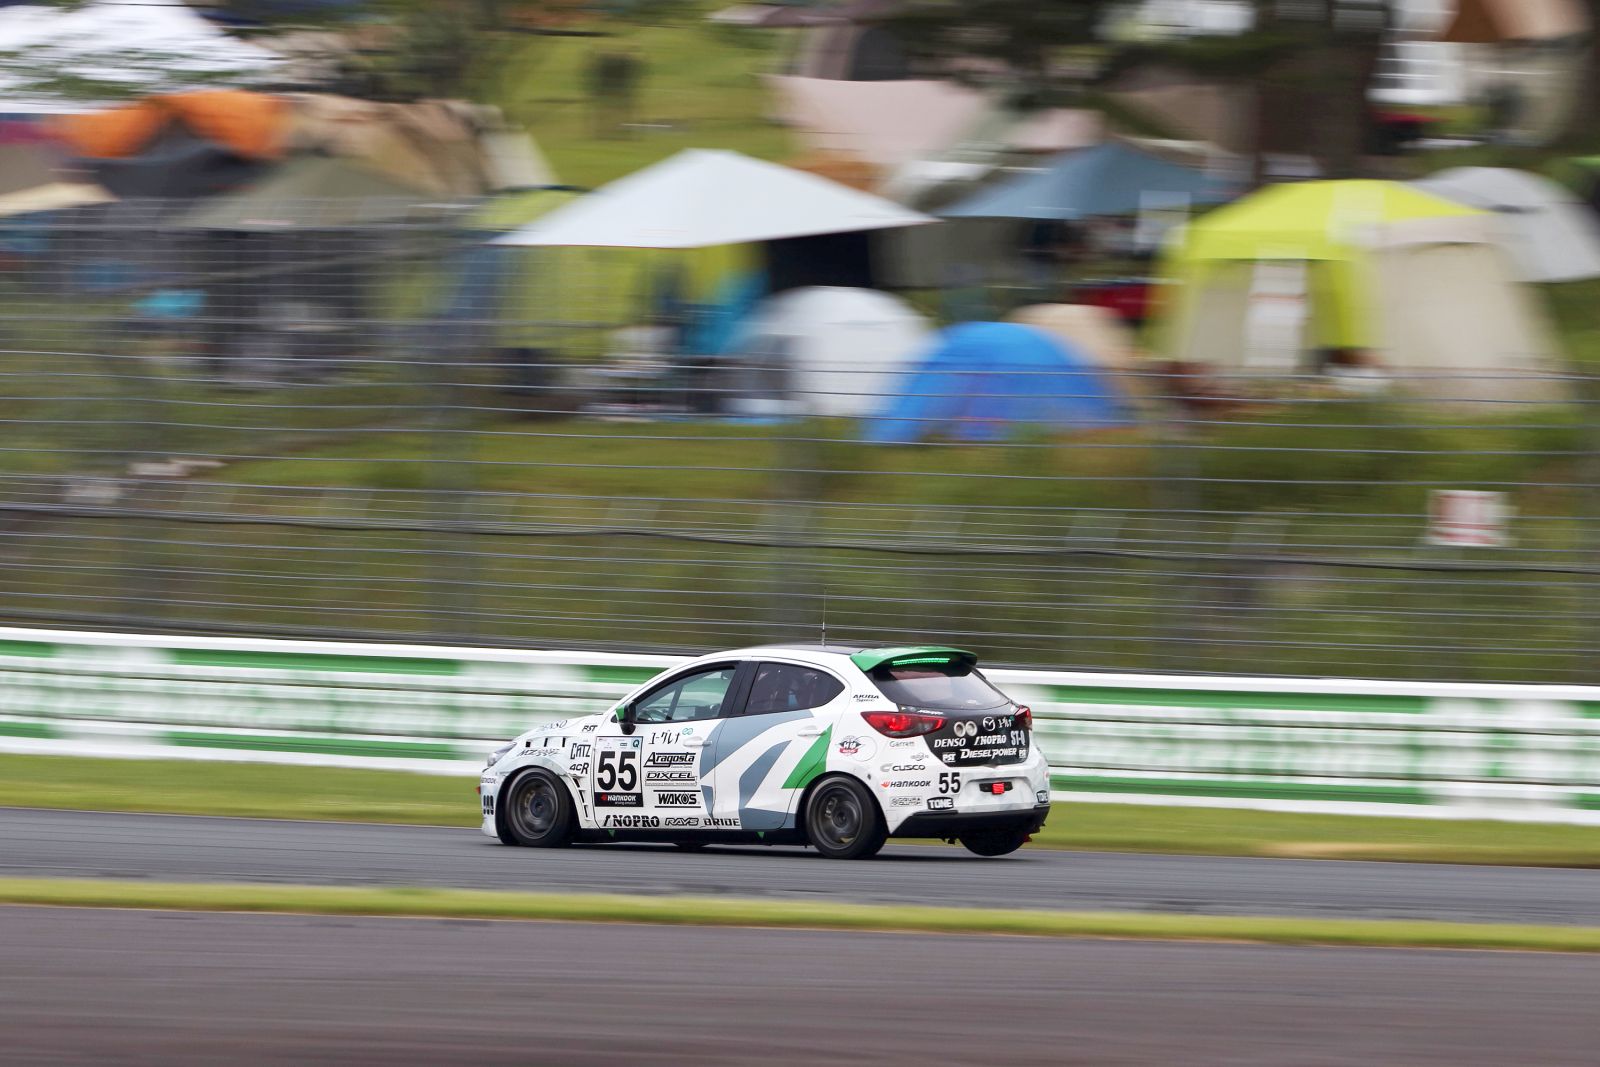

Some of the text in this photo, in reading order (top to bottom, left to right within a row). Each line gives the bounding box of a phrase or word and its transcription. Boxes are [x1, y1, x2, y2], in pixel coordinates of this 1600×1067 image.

[632, 739, 640, 748] Q
[934, 738, 966, 748] DENSO
[570, 742, 591, 760] CATZ
[643, 752, 696, 768] Aragosta
[597, 751, 637, 791] 55
[892, 764, 926, 772] CUSCO
[646, 772, 696, 781] DIXCEL
[938, 772, 961, 794] 55
[929, 800, 952, 809] TONE
[665, 817, 699, 827] RAYS
[703, 818, 740, 827] BRIDE
